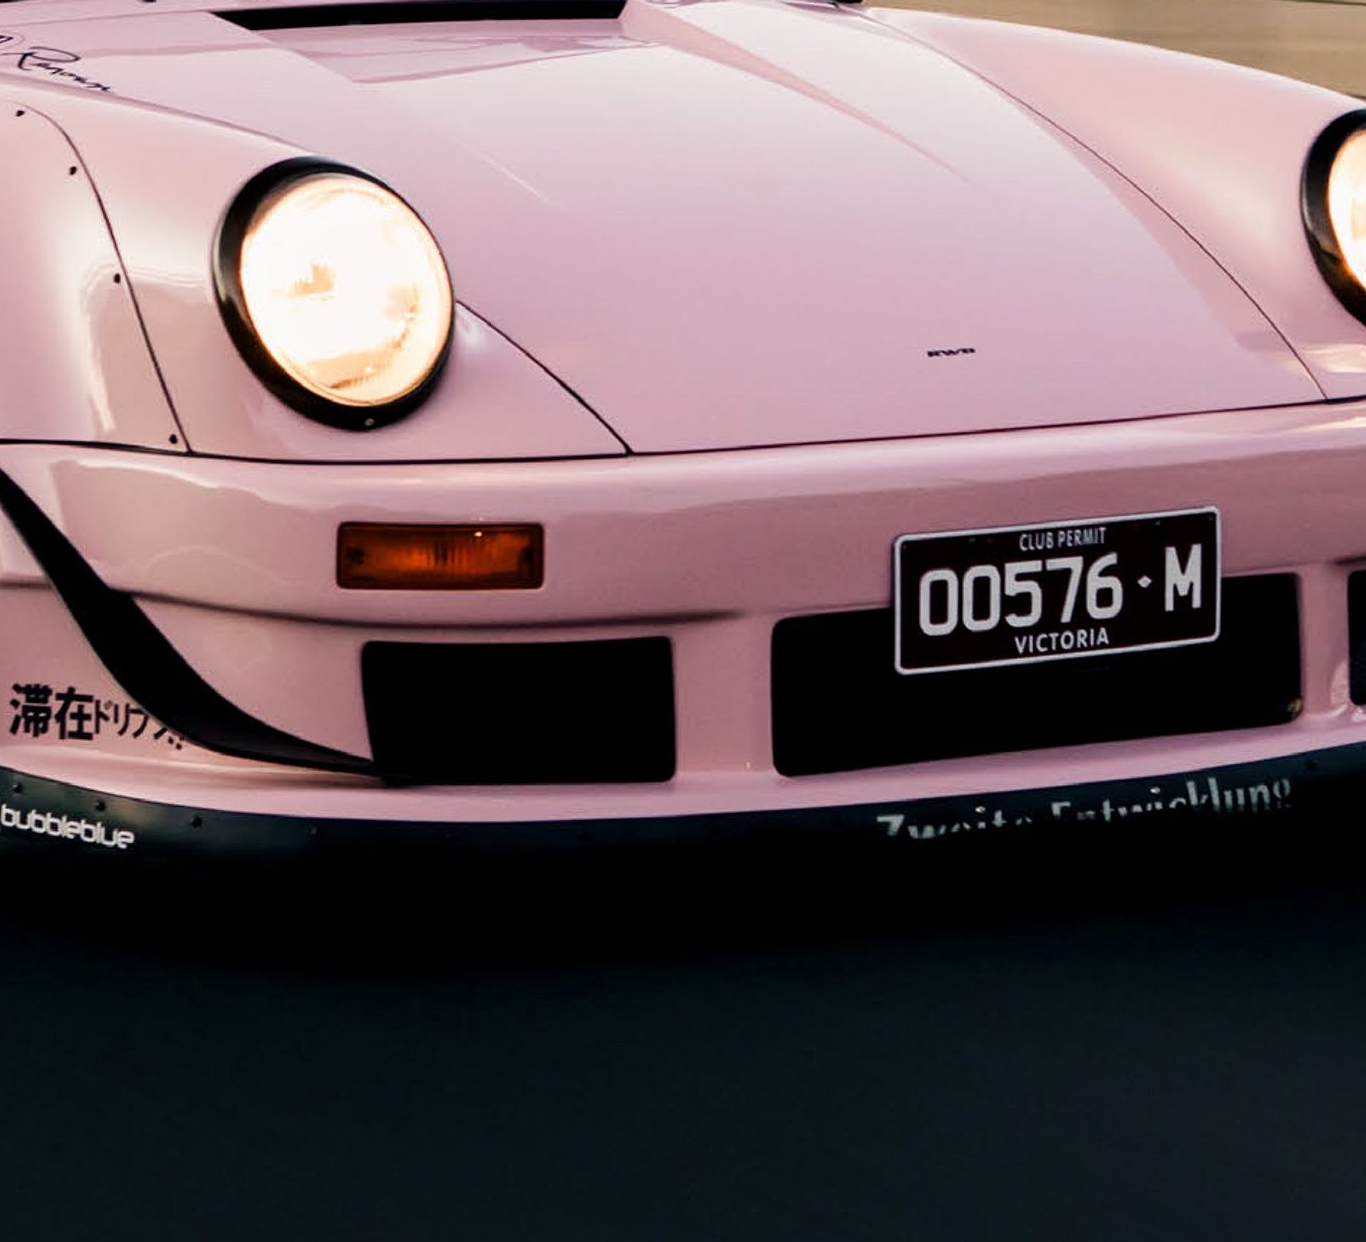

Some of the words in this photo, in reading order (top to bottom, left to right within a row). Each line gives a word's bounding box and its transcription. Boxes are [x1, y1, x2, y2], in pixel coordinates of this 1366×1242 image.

[1019, 530, 1054, 551] CLUB
[1057, 526, 1108, 548] PERMIT
[918, 552, 1124, 637] 00576
[1014, 627, 1110, 655] VICTORIA
[0, 804, 135, 849] bubbleblue
